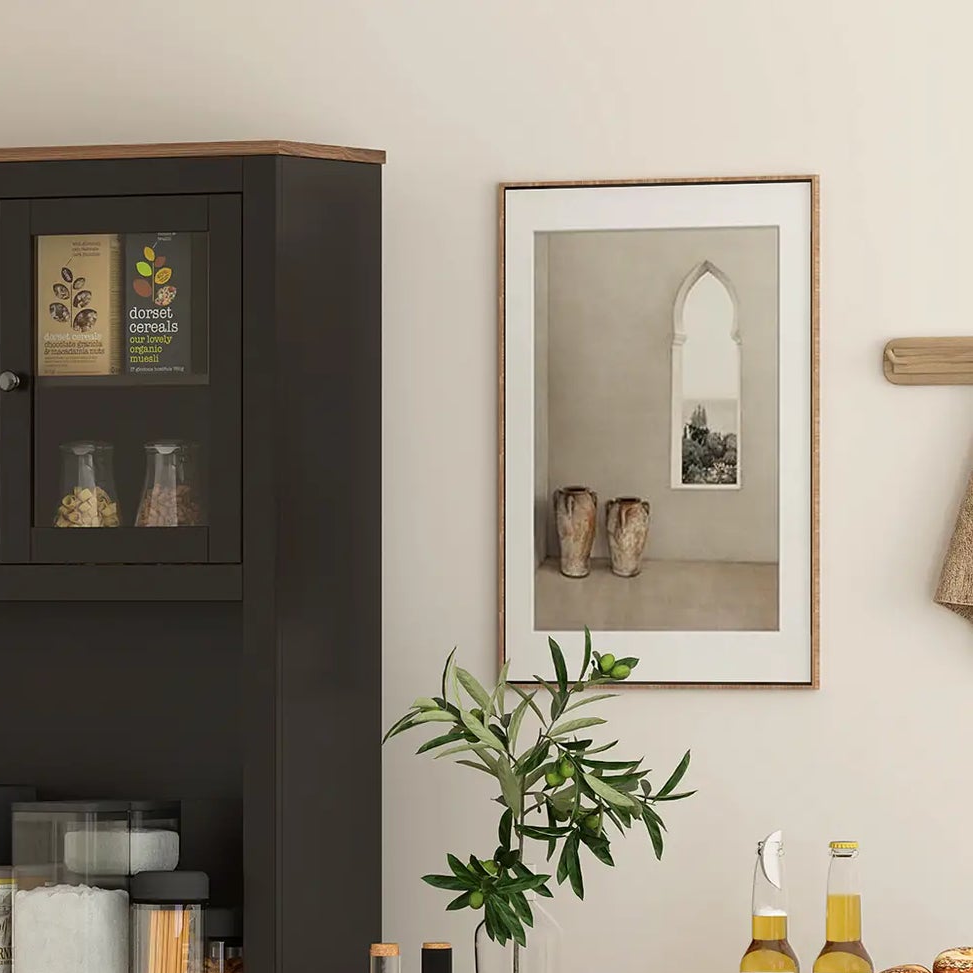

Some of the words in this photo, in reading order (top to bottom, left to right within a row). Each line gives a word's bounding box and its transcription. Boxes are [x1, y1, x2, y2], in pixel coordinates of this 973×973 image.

[129, 306, 173, 320] dorset
[129, 320, 179, 334] cereals
[129, 336, 146, 344] our
[146, 335, 172, 345] lovely
[129, 345, 163, 354] organic
[129, 354, 159, 363] muesli
